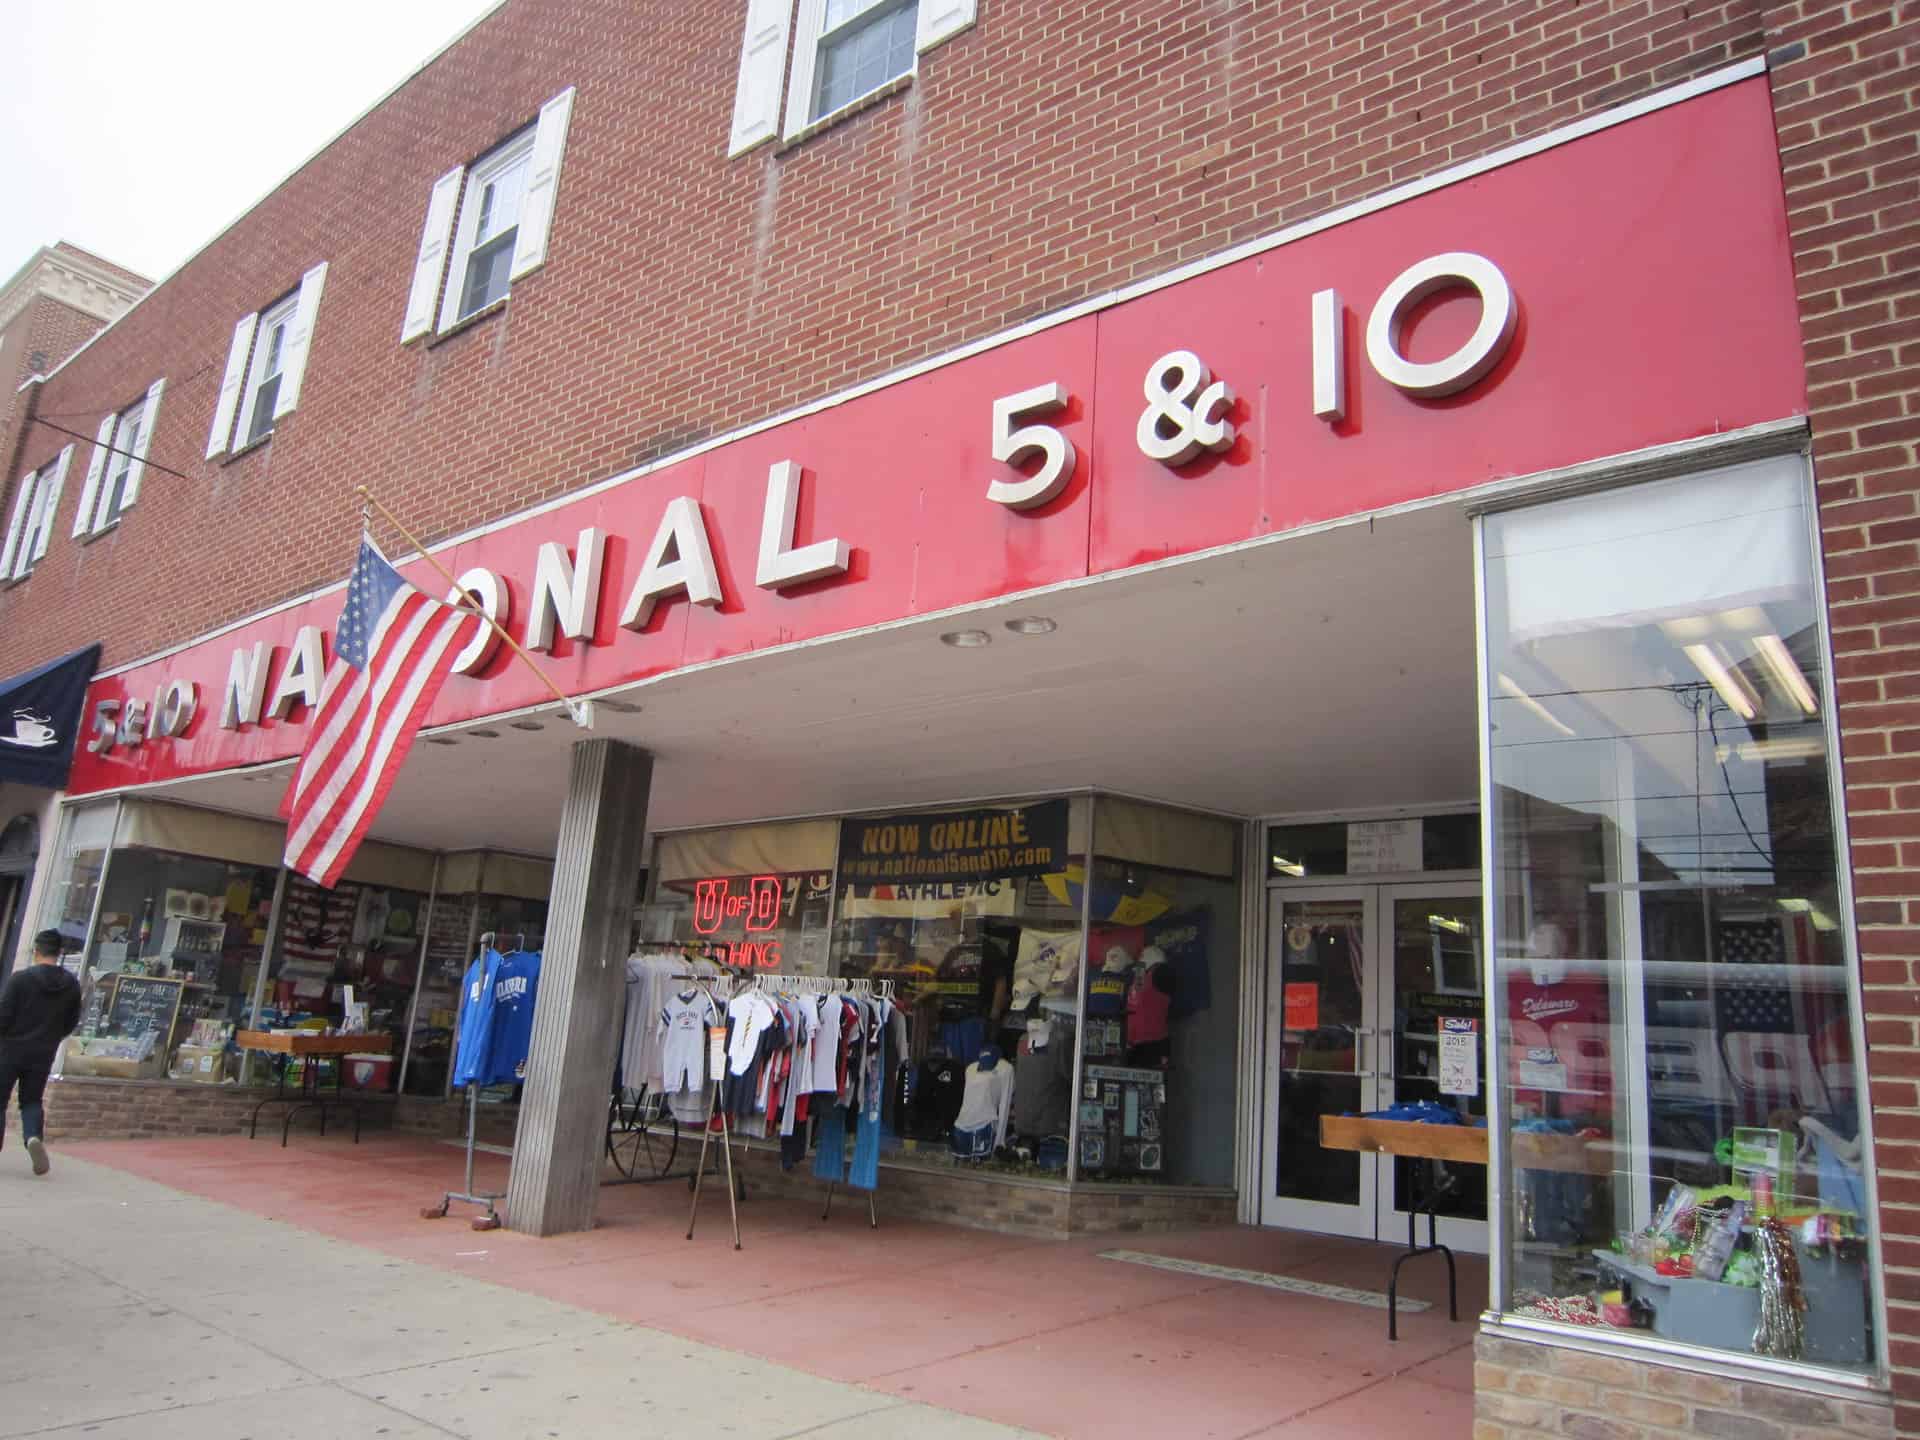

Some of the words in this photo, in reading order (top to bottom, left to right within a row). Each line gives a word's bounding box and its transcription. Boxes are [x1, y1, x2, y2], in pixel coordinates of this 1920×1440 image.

[220, 459, 850, 730] NAONAL
[986, 382, 1076, 510] 5
[1136, 350, 1234, 467] &
[1312, 252, 1518, 422] 10
[862, 824, 919, 852] NOW
[930, 812, 1030, 850] ONLINE
[843, 848, 1051, 876] www.national5and10.com
[694, 879, 729, 934] U
[745, 876, 782, 931] D
[896, 880, 1000, 900] ATHLETIC
[1522, 996, 1578, 1014] Delaware
